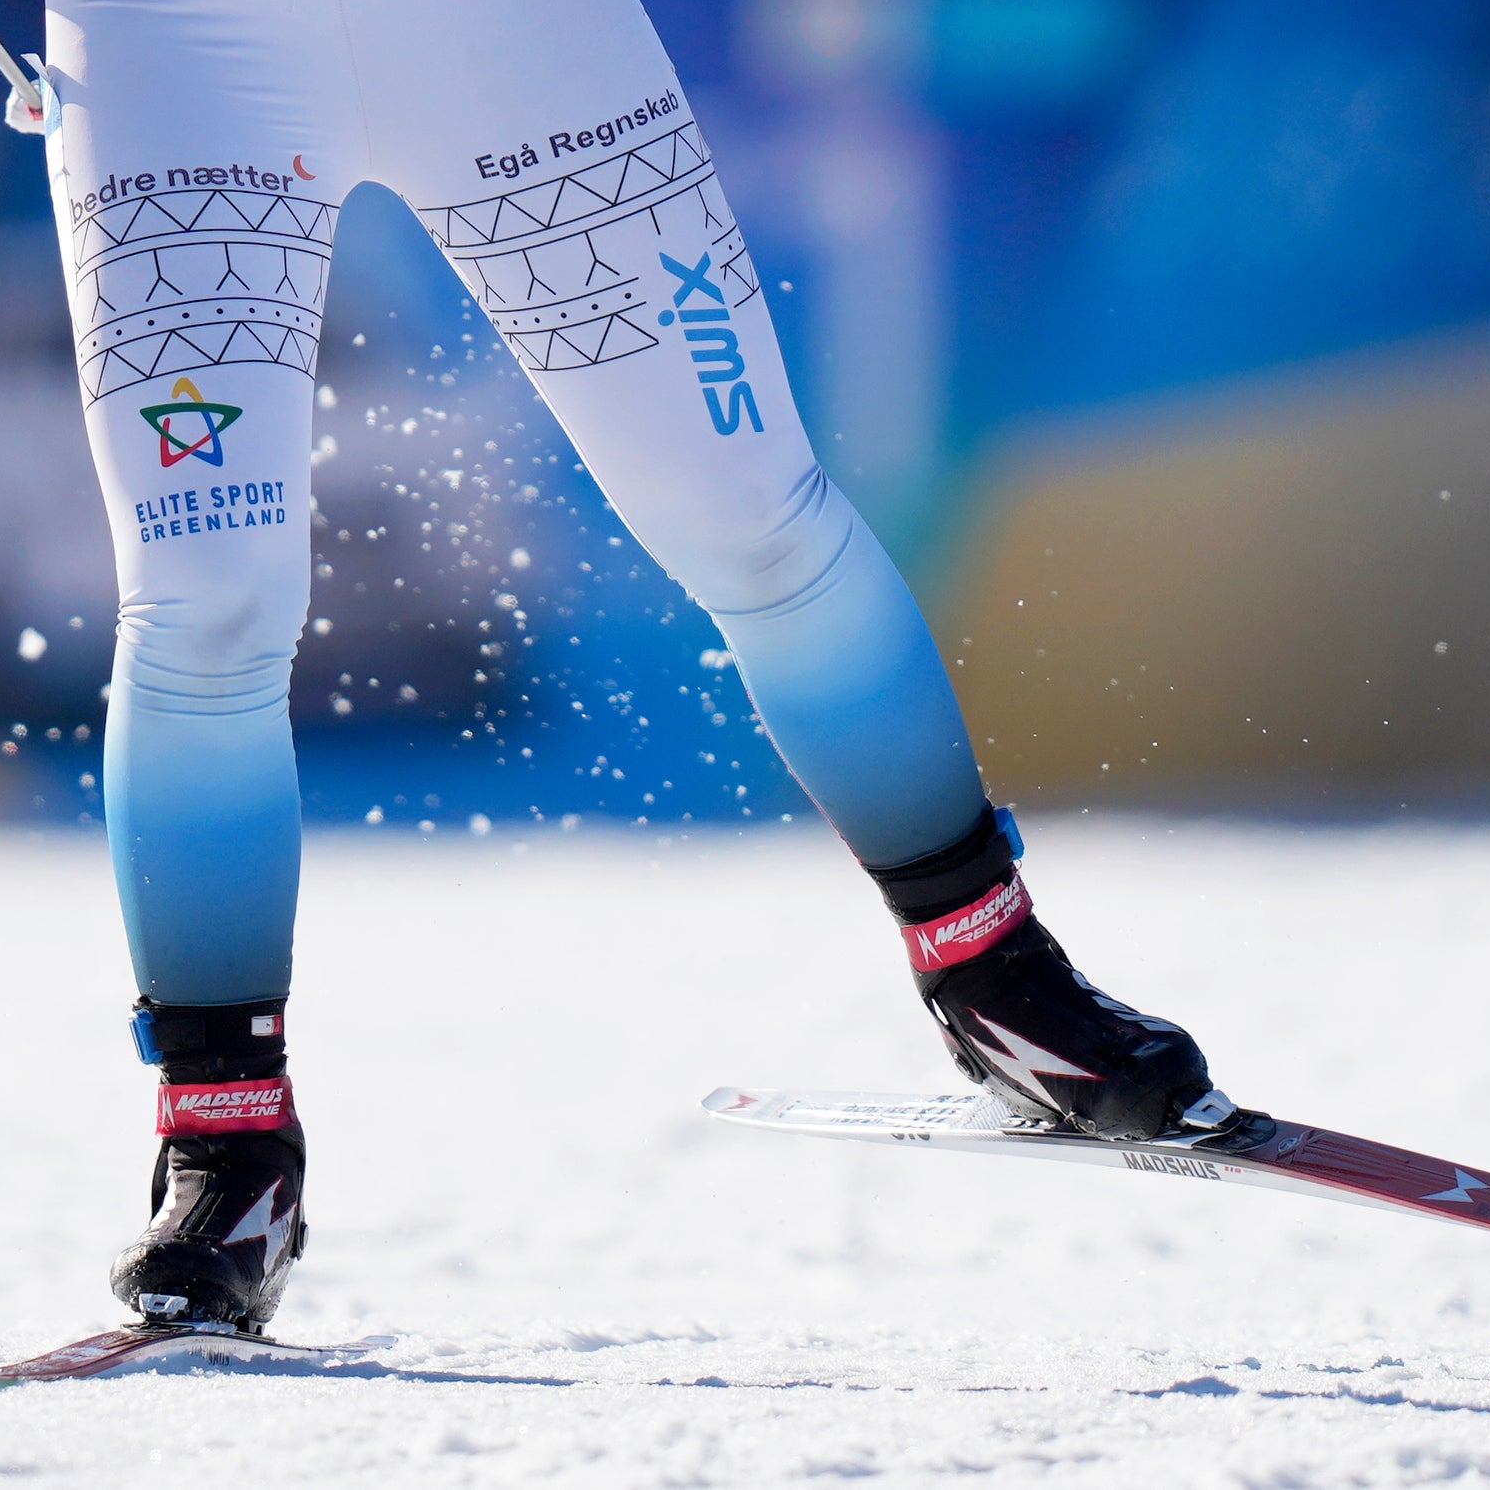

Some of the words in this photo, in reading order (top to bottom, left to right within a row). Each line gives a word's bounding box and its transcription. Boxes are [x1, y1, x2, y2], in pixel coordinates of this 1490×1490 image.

[474, 143, 539, 179] Egå
[548, 88, 680, 158] Regnskab
[70, 172, 156, 224] bedre
[167, 164, 294, 193] nætter
[135, 490, 199, 524] ELITE
[210, 481, 283, 508] SPORT
[141, 508, 285, 543] GREENLAND
[934, 876, 1021, 946] MADSHUS
[953, 895, 1022, 943] REDLINE
[174, 1088, 283, 1110] MADSHUS
[191, 1104, 280, 1119] REDLINE
[1121, 1151, 1222, 1181] MADSHUS
